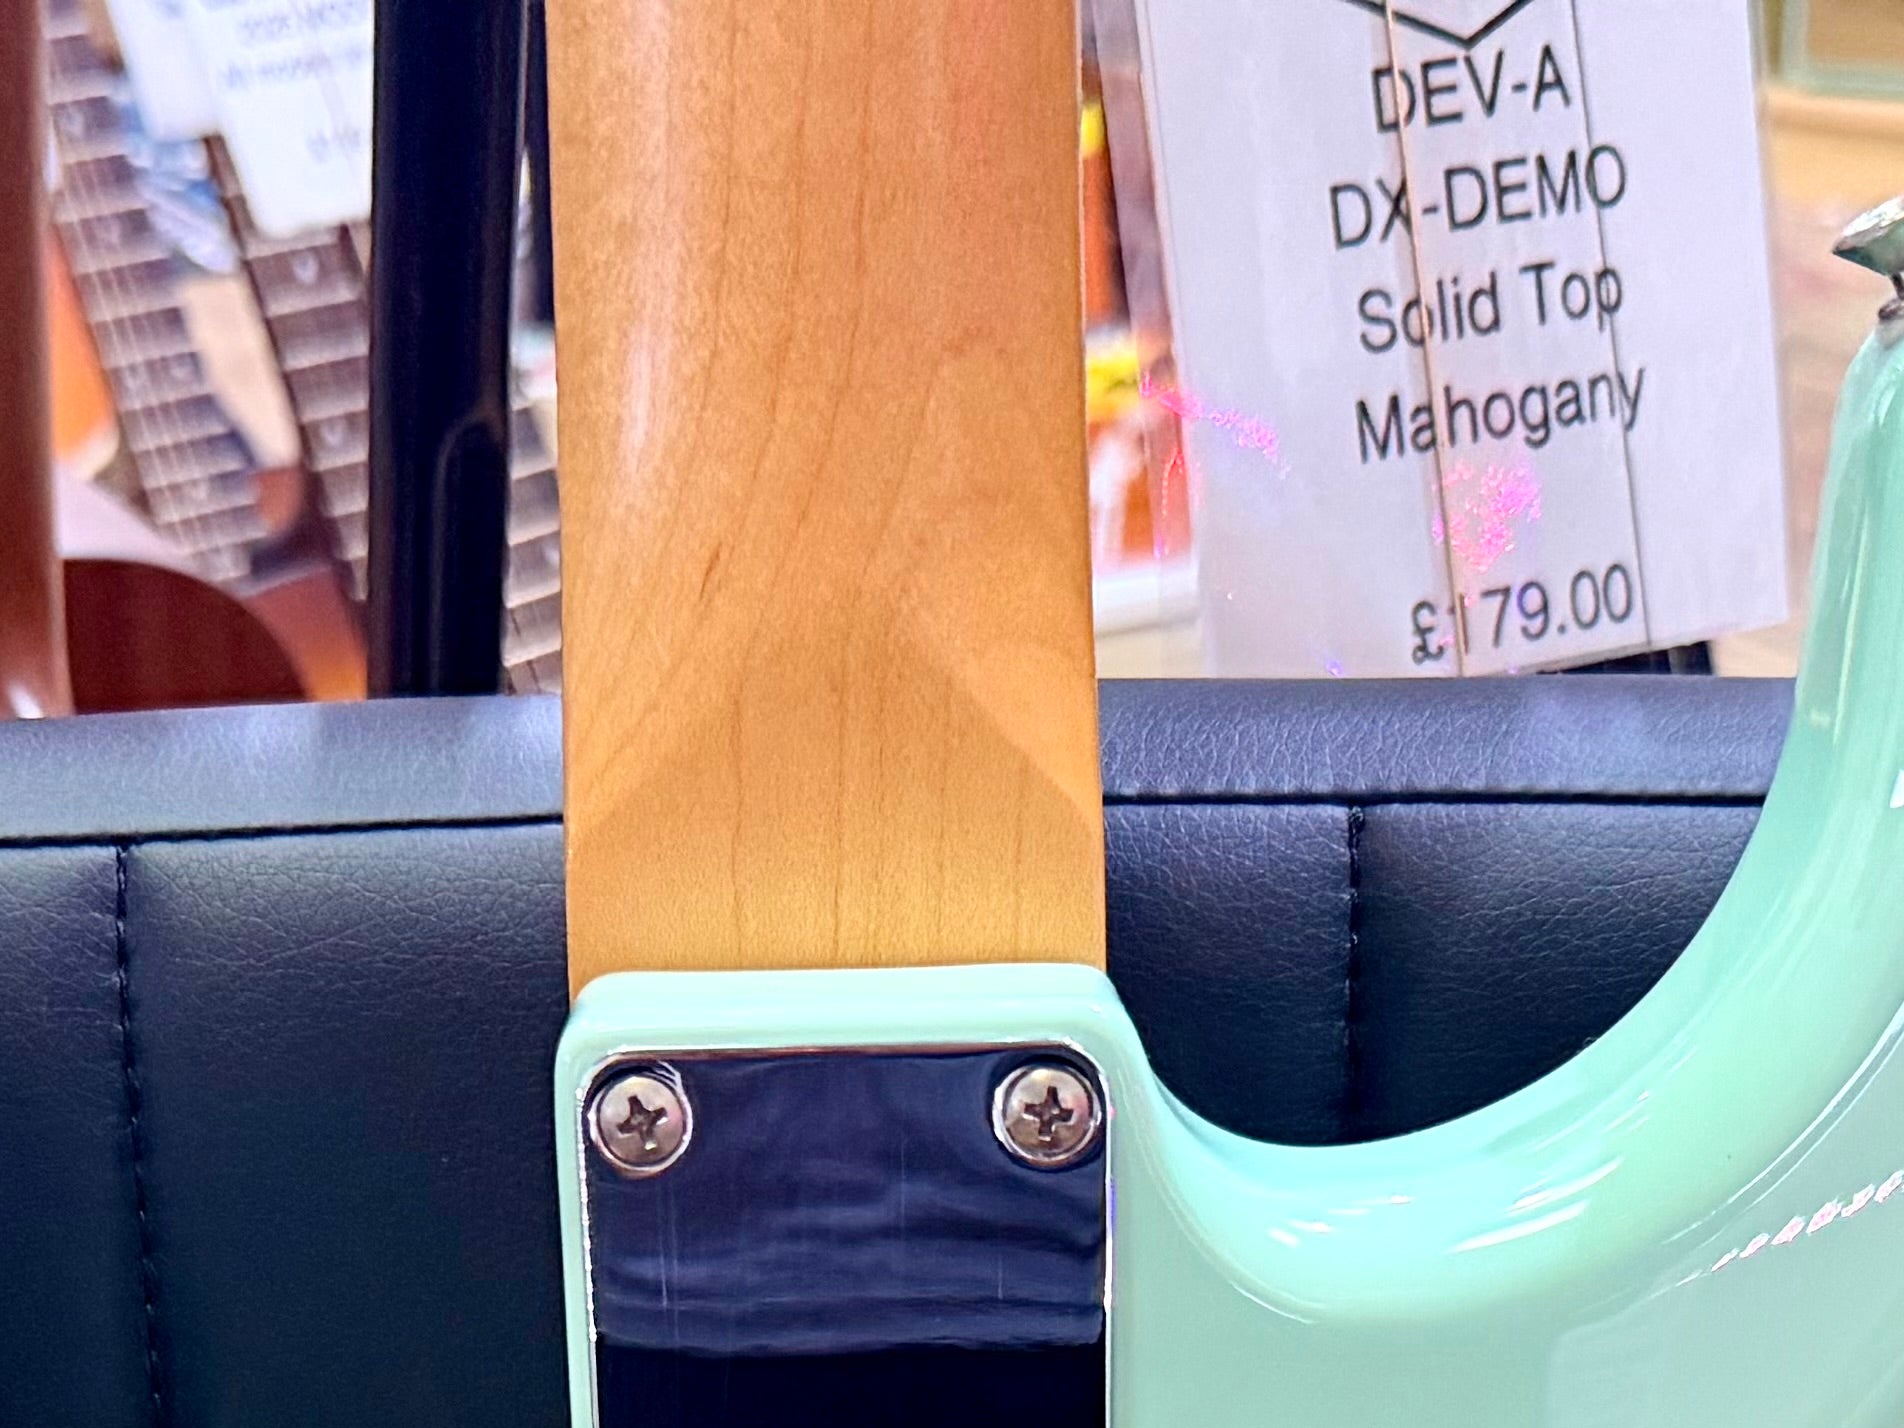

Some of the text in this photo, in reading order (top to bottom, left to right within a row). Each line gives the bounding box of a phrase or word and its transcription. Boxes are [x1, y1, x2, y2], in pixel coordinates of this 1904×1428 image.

[1371, 44, 1572, 134] DEV-A
[1329, 144, 1627, 251] DX-DEMO
[1358, 260, 1623, 354] Solid Top
[1355, 367, 1646, 465] Mahogany
[1411, 562, 1633, 666] £179.00
